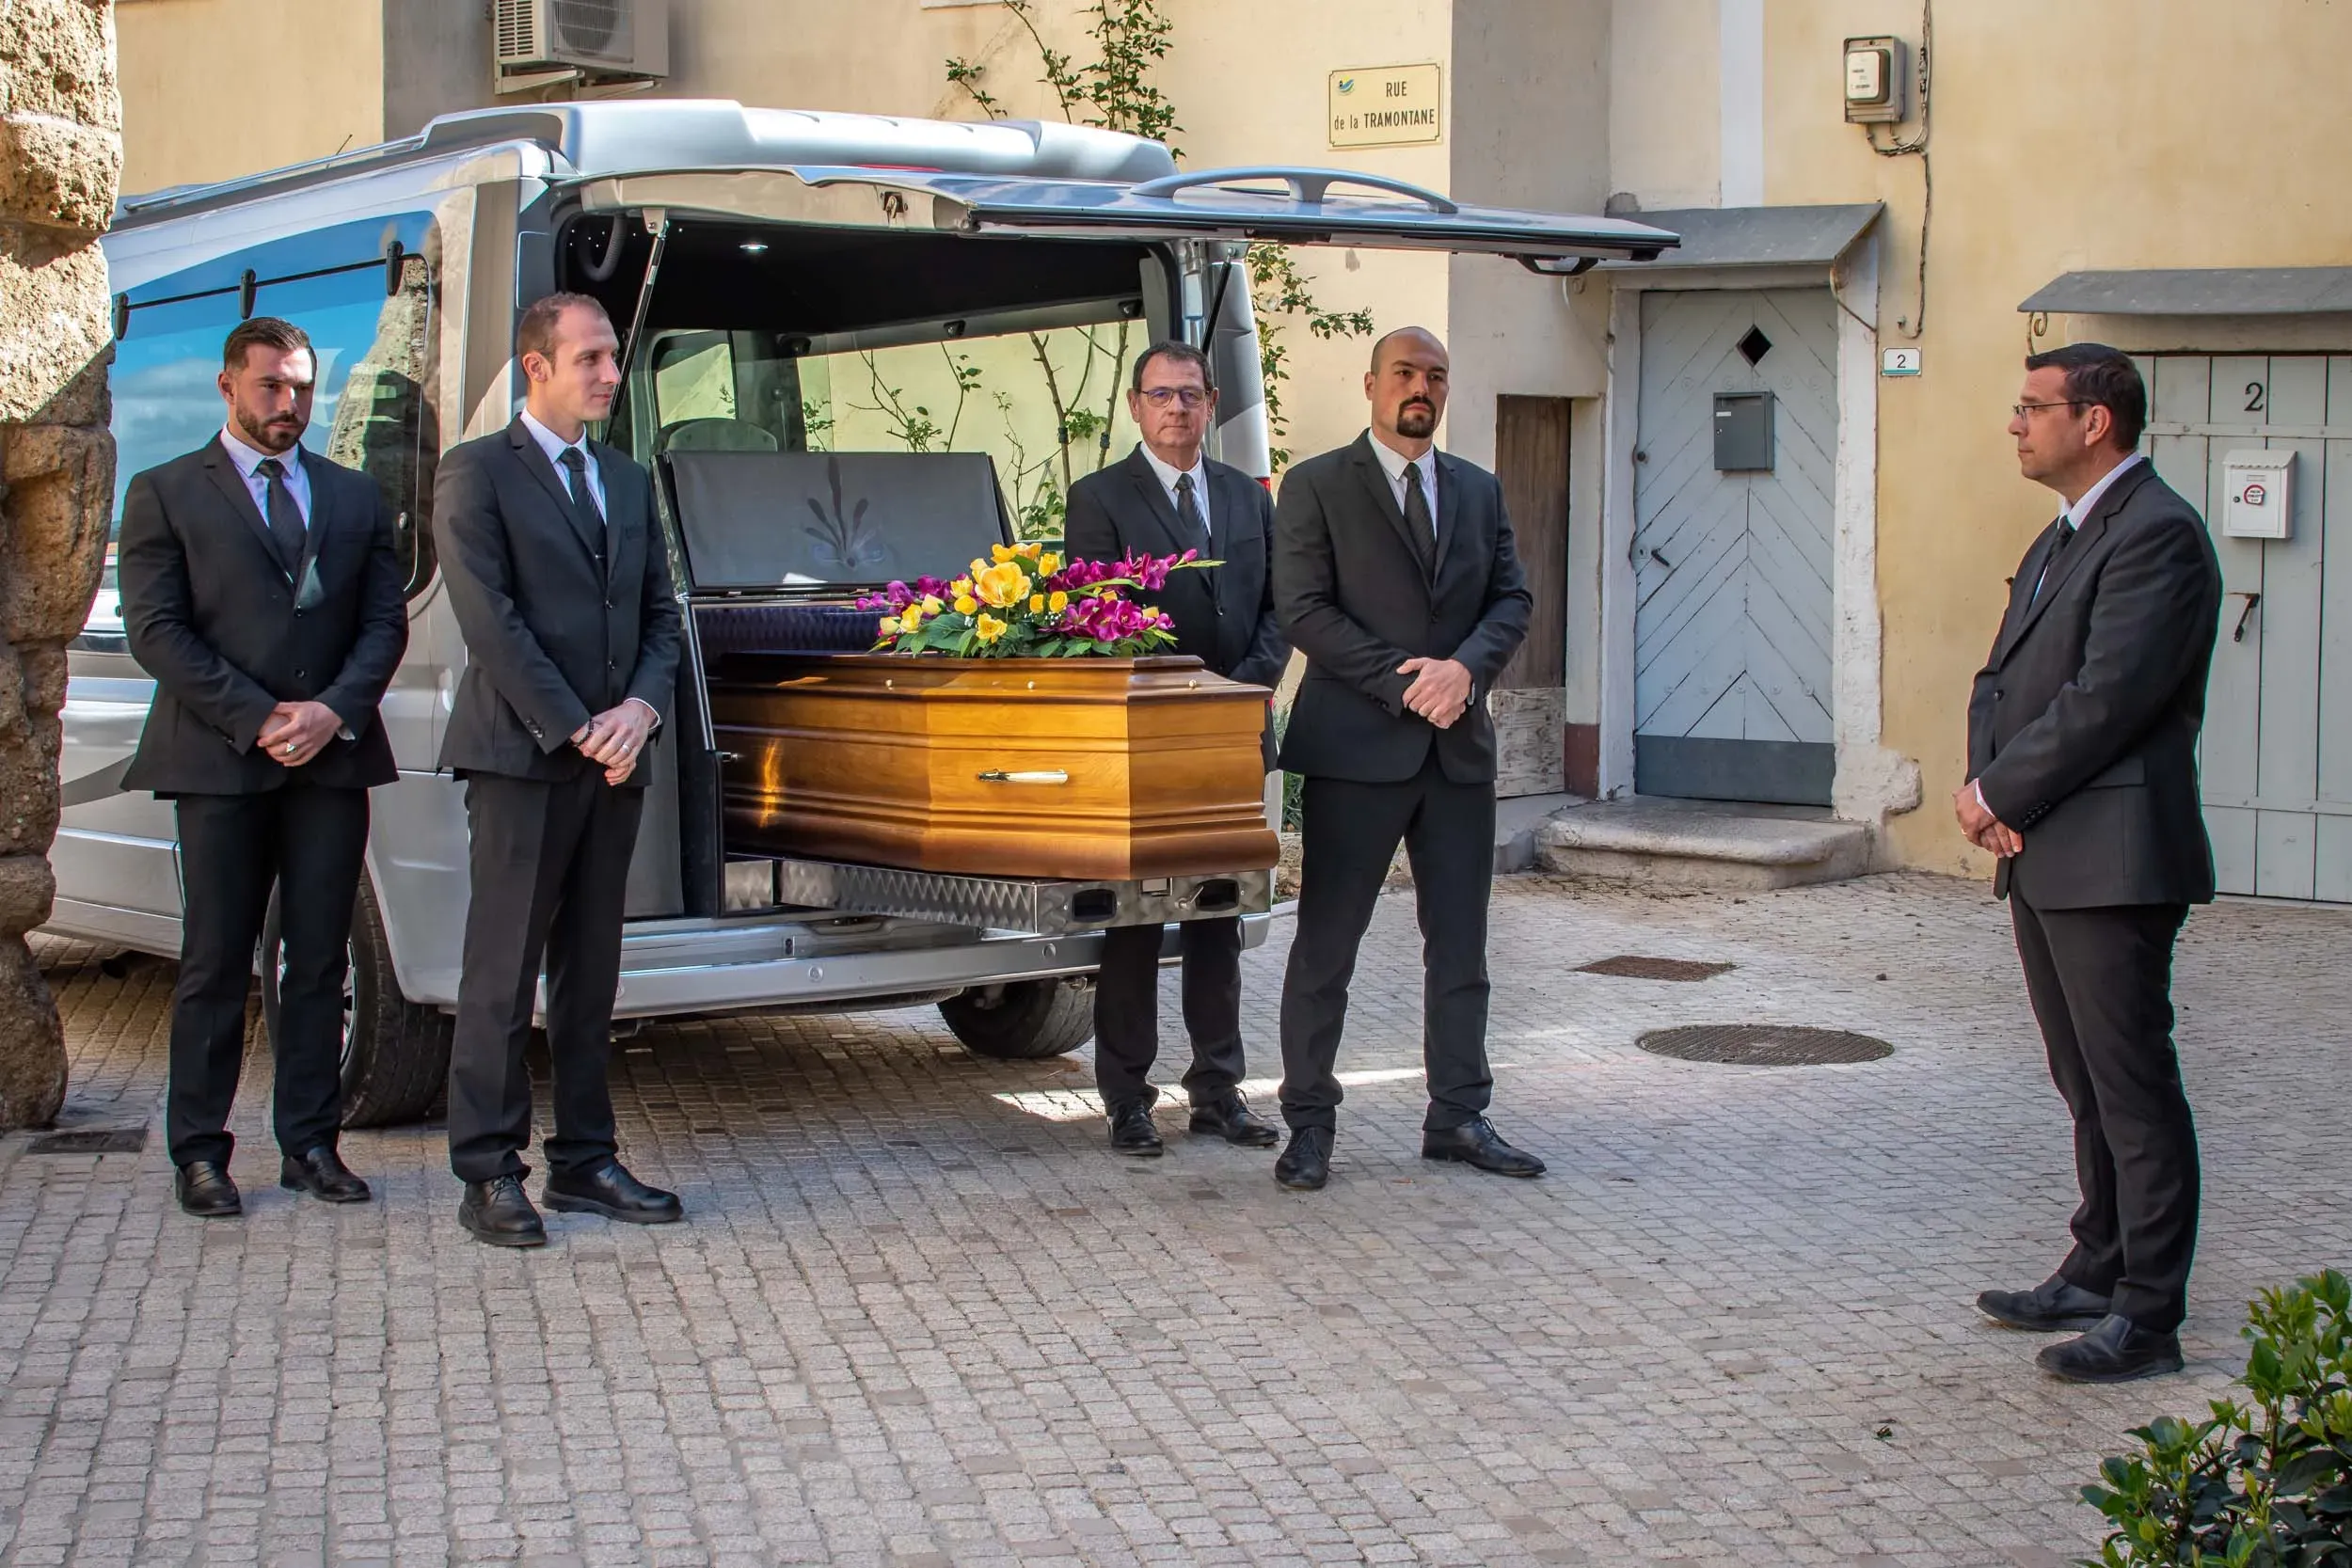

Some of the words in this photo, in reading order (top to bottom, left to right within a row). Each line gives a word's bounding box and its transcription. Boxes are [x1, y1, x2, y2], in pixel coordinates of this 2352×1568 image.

[1386, 81, 1407, 98] RUE
[1334, 115, 1344, 130] de
[1350, 114, 1359, 129] la
[1364, 108, 1435, 128] TRAMONTANE
[1897, 354, 1906, 369] 2
[2244, 382, 2264, 412] 2
